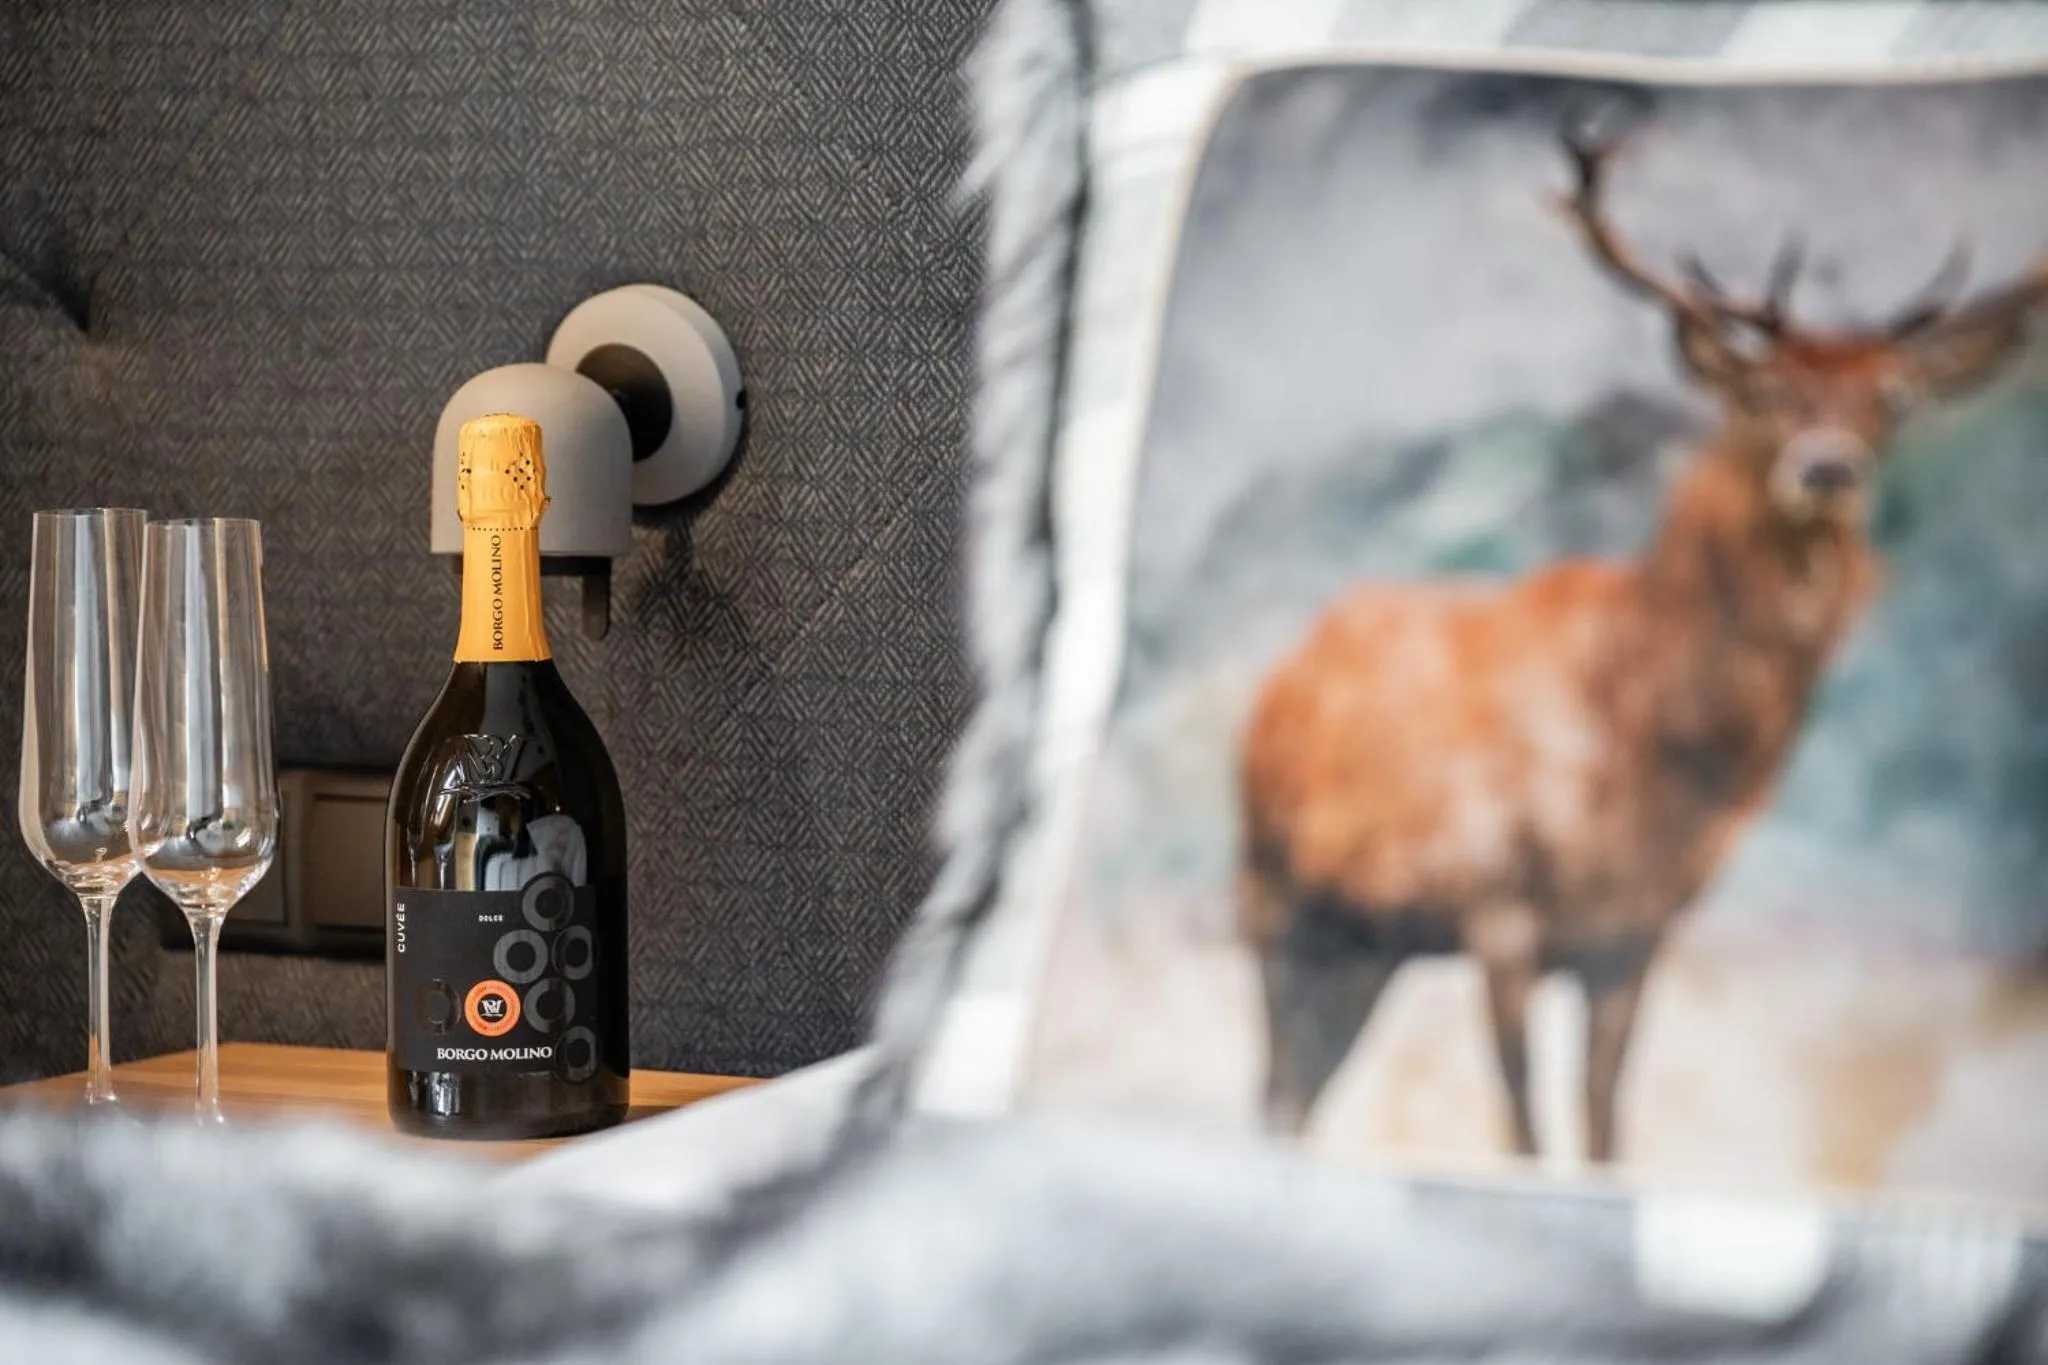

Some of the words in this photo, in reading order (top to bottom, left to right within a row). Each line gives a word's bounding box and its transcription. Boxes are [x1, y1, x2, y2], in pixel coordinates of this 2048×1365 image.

[490, 534, 503, 596] MOLINO
[492, 598, 504, 651] BORGO
[396, 902, 406, 953] CUVÉE
[436, 1047, 488, 1061] BORGO
[490, 1046, 553, 1061] MOLINO
